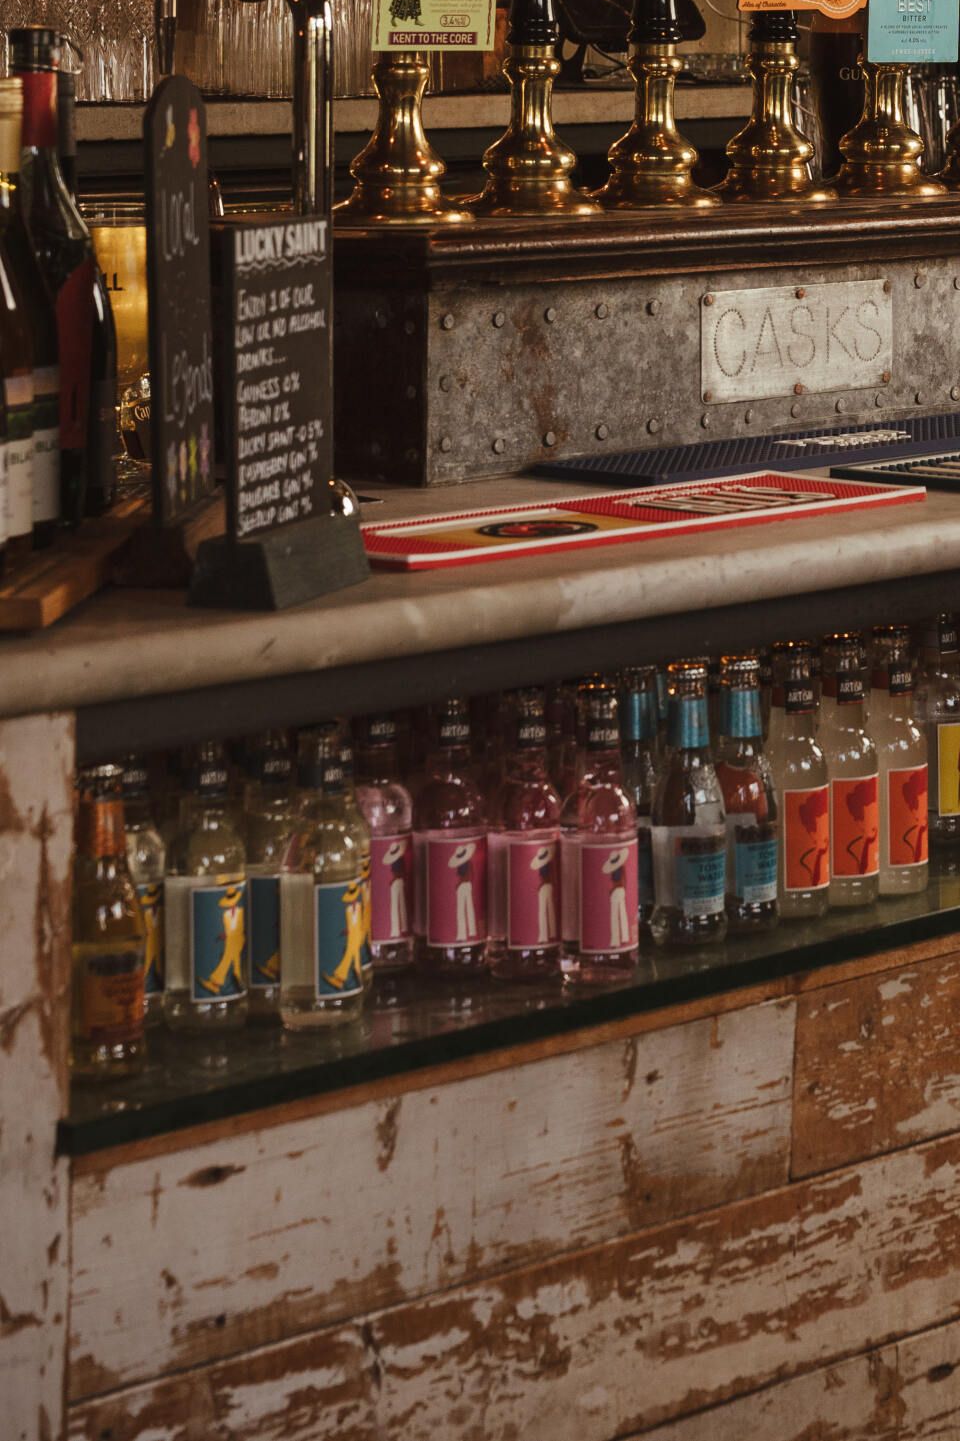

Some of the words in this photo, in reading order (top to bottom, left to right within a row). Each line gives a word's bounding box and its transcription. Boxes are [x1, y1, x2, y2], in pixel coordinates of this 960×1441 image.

[902, 15, 927, 23] BITTER
[392, 33, 417, 44] KENT
[418, 33, 430, 44] TO
[431, 34, 448, 44] THE
[449, 34, 473, 44] CORE
[235, 225, 285, 265] LUCKY
[285, 220, 328, 257] SAINT
[272, 317, 287, 338] NO
[713, 299, 883, 378] CASKS
